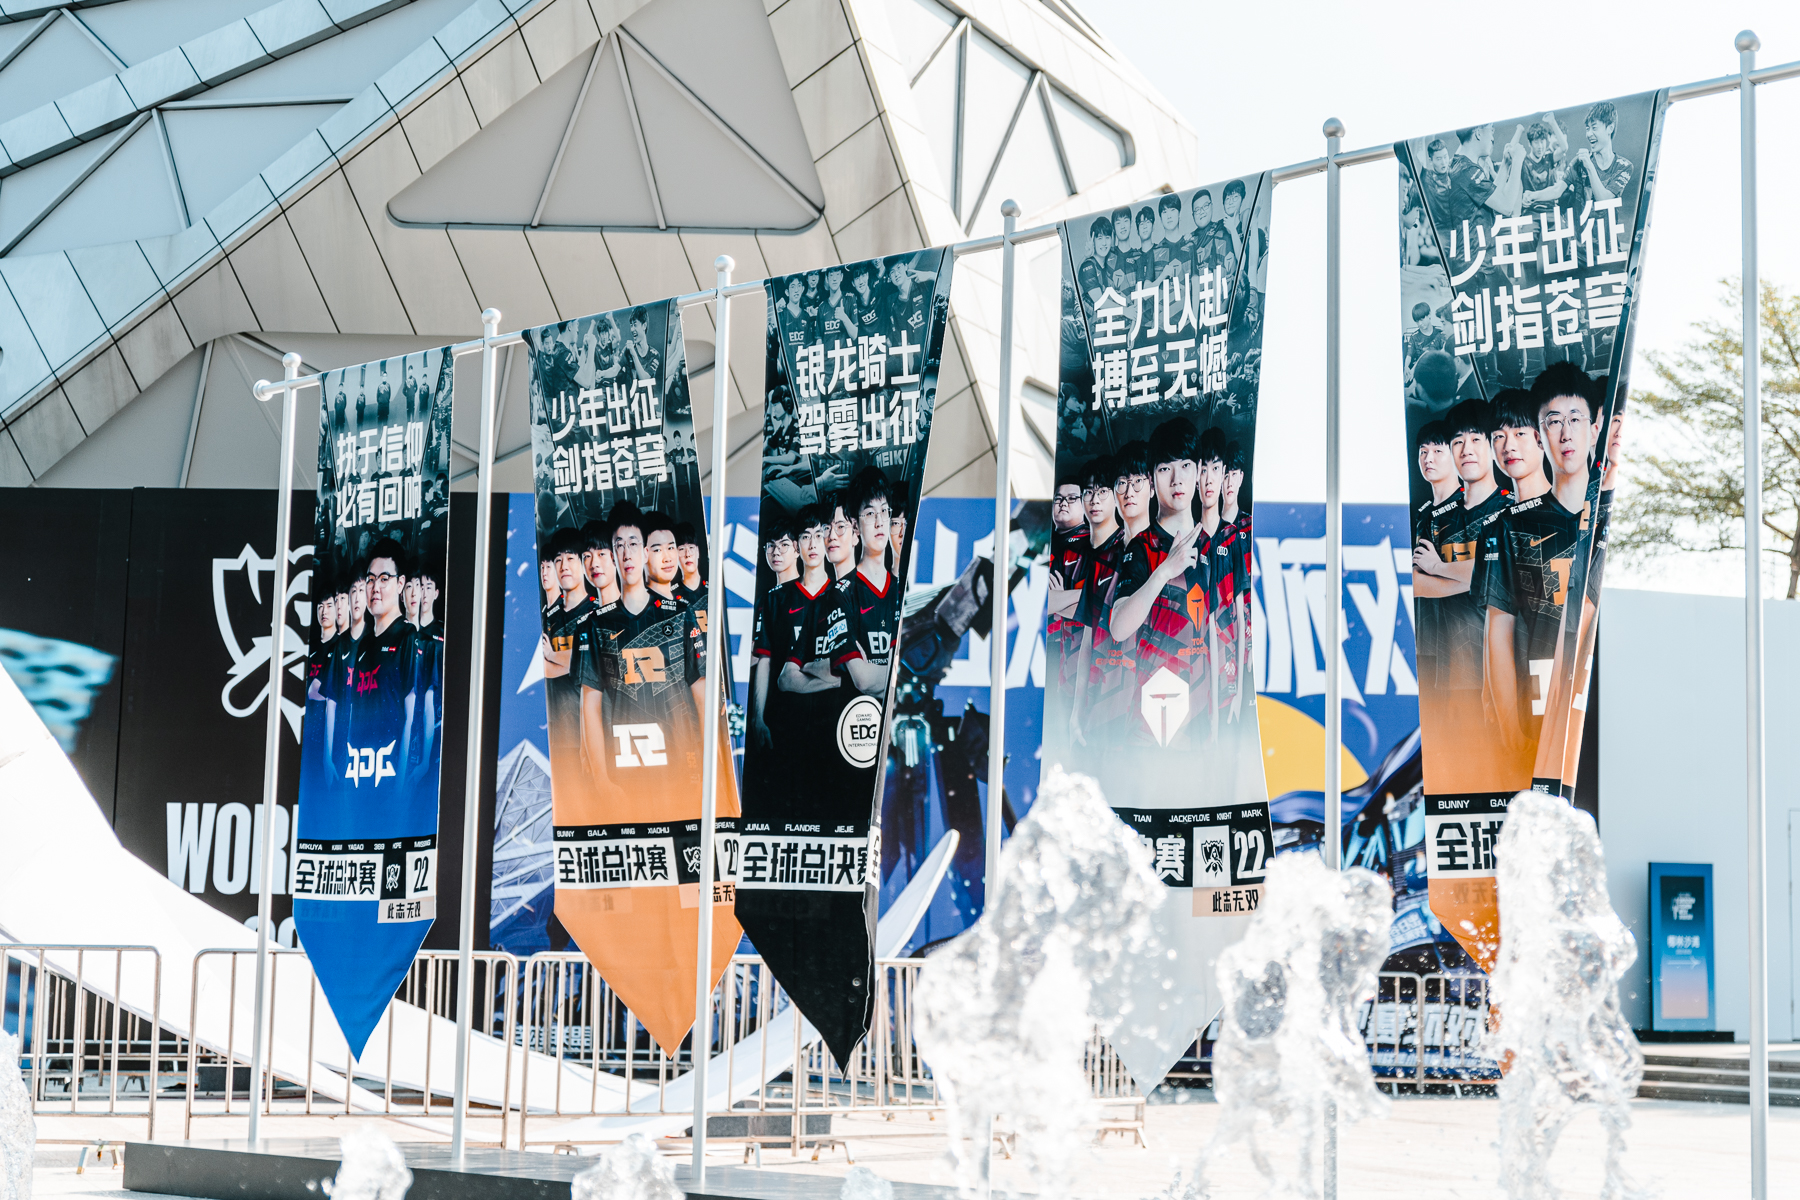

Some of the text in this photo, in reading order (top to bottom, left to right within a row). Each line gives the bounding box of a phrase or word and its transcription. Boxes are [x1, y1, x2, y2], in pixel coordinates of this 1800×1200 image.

[1450, 197, 1628, 287] 少年出征
[824, 319, 840, 331] EDG
[1093, 264, 1229, 347] 全力以赴
[1450, 271, 1628, 357] 剑指苍穹
[788, 331, 805, 342] EDG
[796, 330, 921, 398] 银龙骑士
[1091, 329, 1229, 411] 搏至无憾
[552, 378, 662, 442] 少年出征
[799, 390, 921, 455] 驾雾出征
[336, 421, 424, 479] 执于信仰
[552, 433, 669, 495] 剑指苍穹
[336, 471, 422, 528] 必有回响
[827, 607, 846, 625] TCL
[867, 631, 892, 655] ED
[849, 723, 878, 741] EDG
[1133, 813, 1152, 823] TIAN
[1168, 813, 1211, 823] JACKEYLOVE
[1241, 808, 1264, 819] MARK
[1438, 799, 1470, 810] BUNNY
[167, 802, 300, 895] WOR
[298, 843, 323, 852] MIKUYA
[373, 843, 386, 851] 369
[556, 829, 575, 838] BUNNY
[587, 829, 608, 837] GALA
[685, 823, 698, 832] WEI
[744, 823, 855, 834] JUNJIA FLANDRE JIEJIE
[557, 844, 669, 884] 全球总决赛
[1233, 829, 1267, 880] 22
[294, 855, 430, 896] 全球总决赛 22
[1212, 888, 1260, 913] 此志无双
